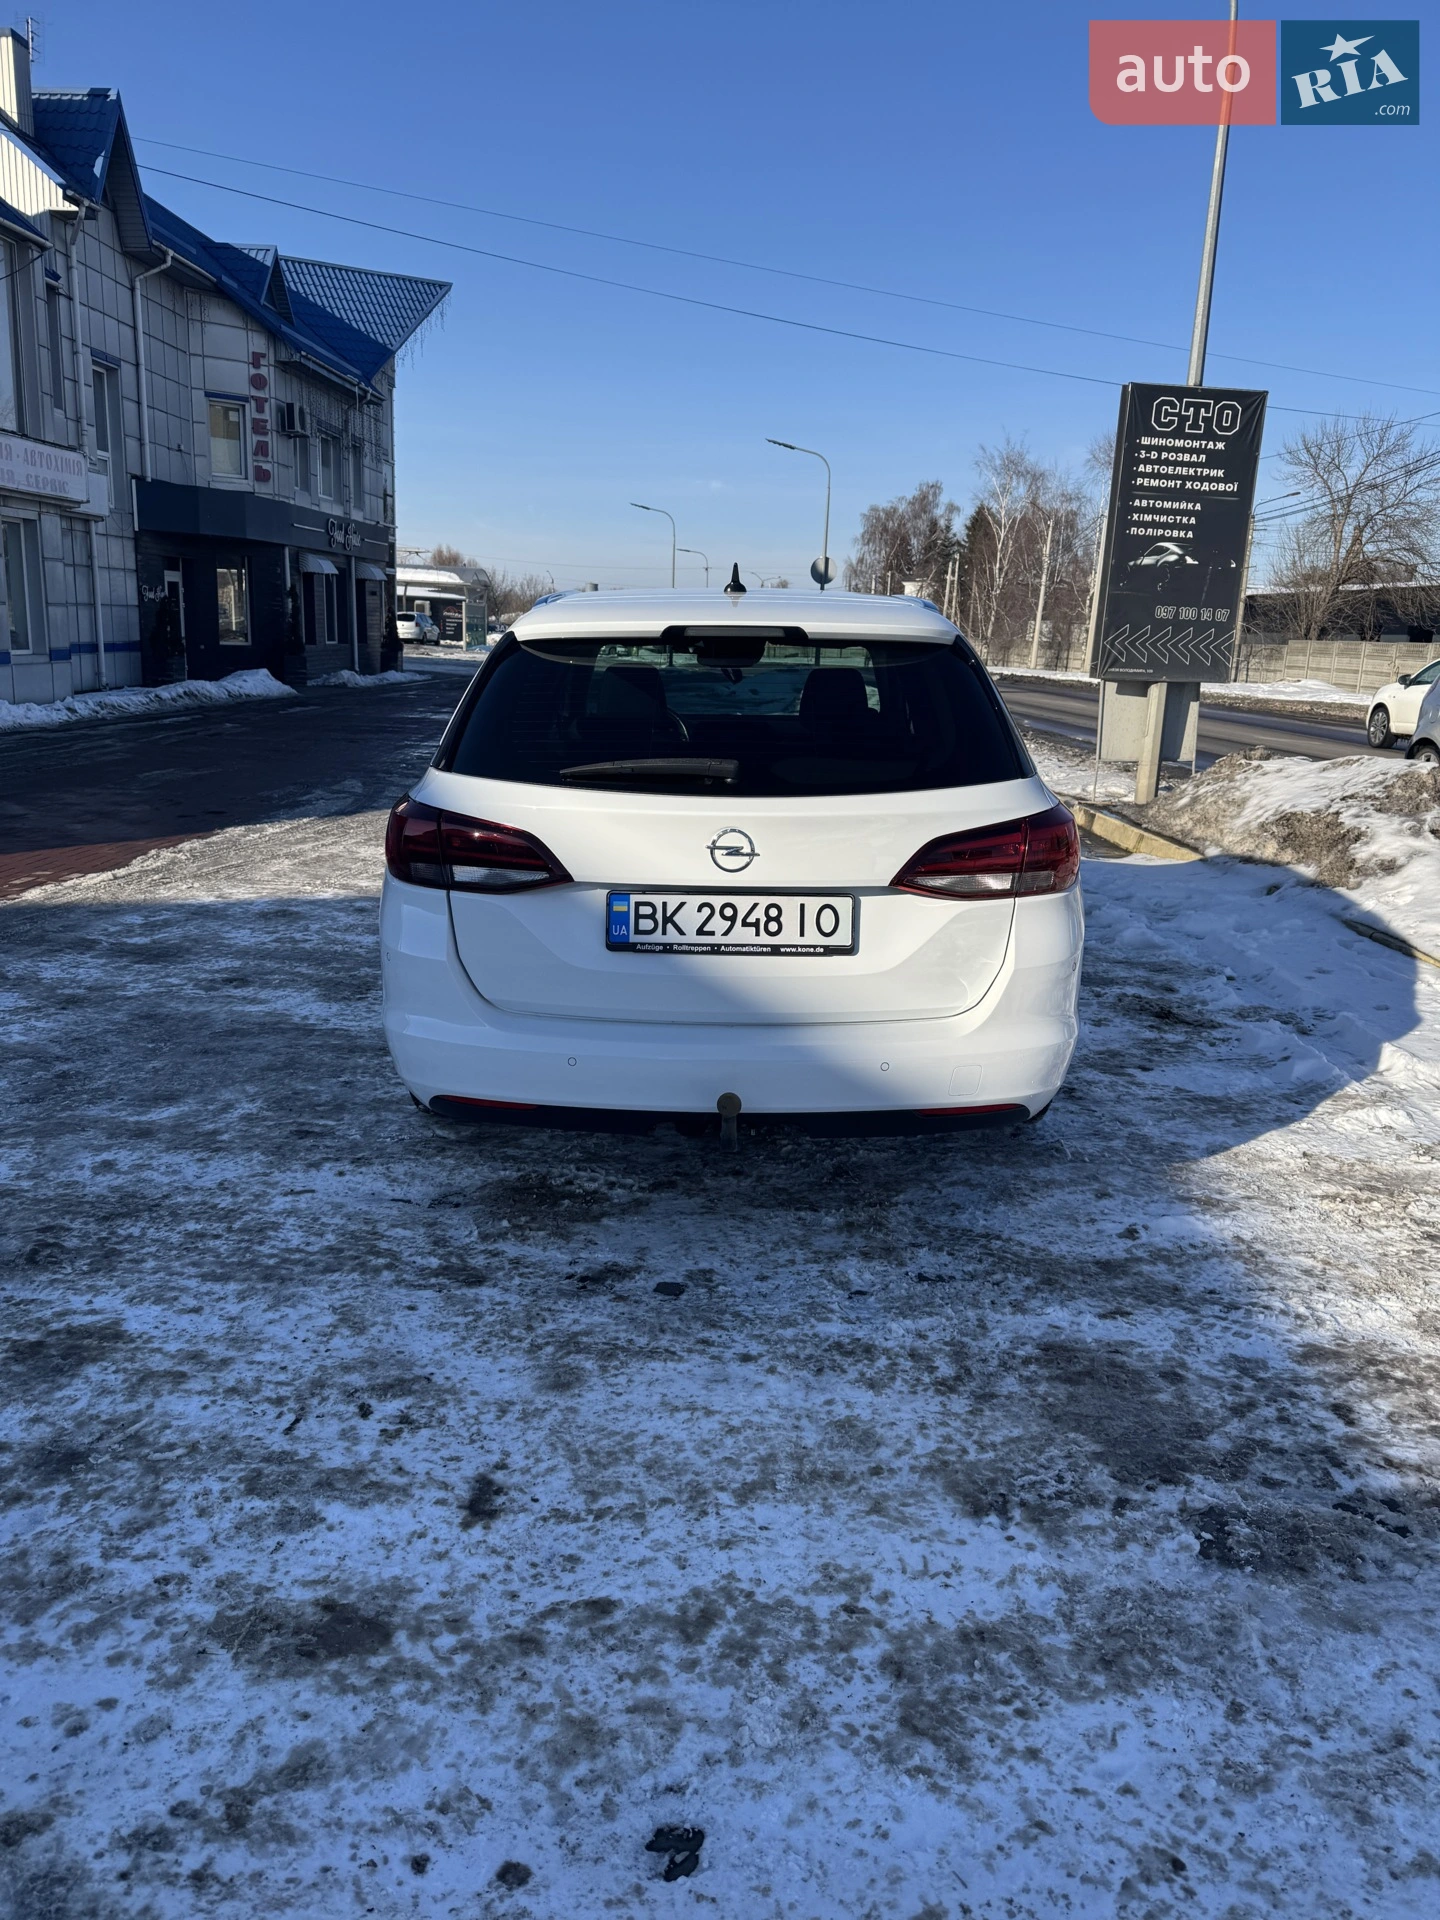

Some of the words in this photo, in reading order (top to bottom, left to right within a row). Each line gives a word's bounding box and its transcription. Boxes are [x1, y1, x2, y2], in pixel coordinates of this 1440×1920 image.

[250, 350, 272, 483] ГОТЕЛЬ
[1151, 396, 1242, 436] СТО
[1141, 436, 1226, 450] ШИНОМОНТАЖ
[23, 447, 83, 477] АВТОХІМІЯ
[1139, 451, 1158, 460] 3-D
[1161, 452, 1206, 463] РОЗВАЛ
[1138, 464, 1225, 477] АВТОЕЛЕКТРИК
[25, 473, 70, 494] СЕРВІС
[1136, 478, 1182, 489] РЕМОНТ
[1185, 480, 1238, 492] ХОДОВОЇ
[1133, 498, 1202, 511] АВТОМИЙКА
[1132, 513, 1196, 525] ХІМЧИСТКА
[1130, 527, 1194, 538] ПОЛІРОВКА
[1155, 605, 1177, 620] 097
[1178, 606, 1198, 620] 100
[1200, 607, 1213, 621] 14
[1215, 608, 1230, 622] 07
[633, 901, 687, 936] BK
[695, 902, 783, 937] 2948
[612, 925, 628, 936] UA
[636, 943, 664, 951] Aufzüge
[672, 944, 711, 952] Rolltreppen
